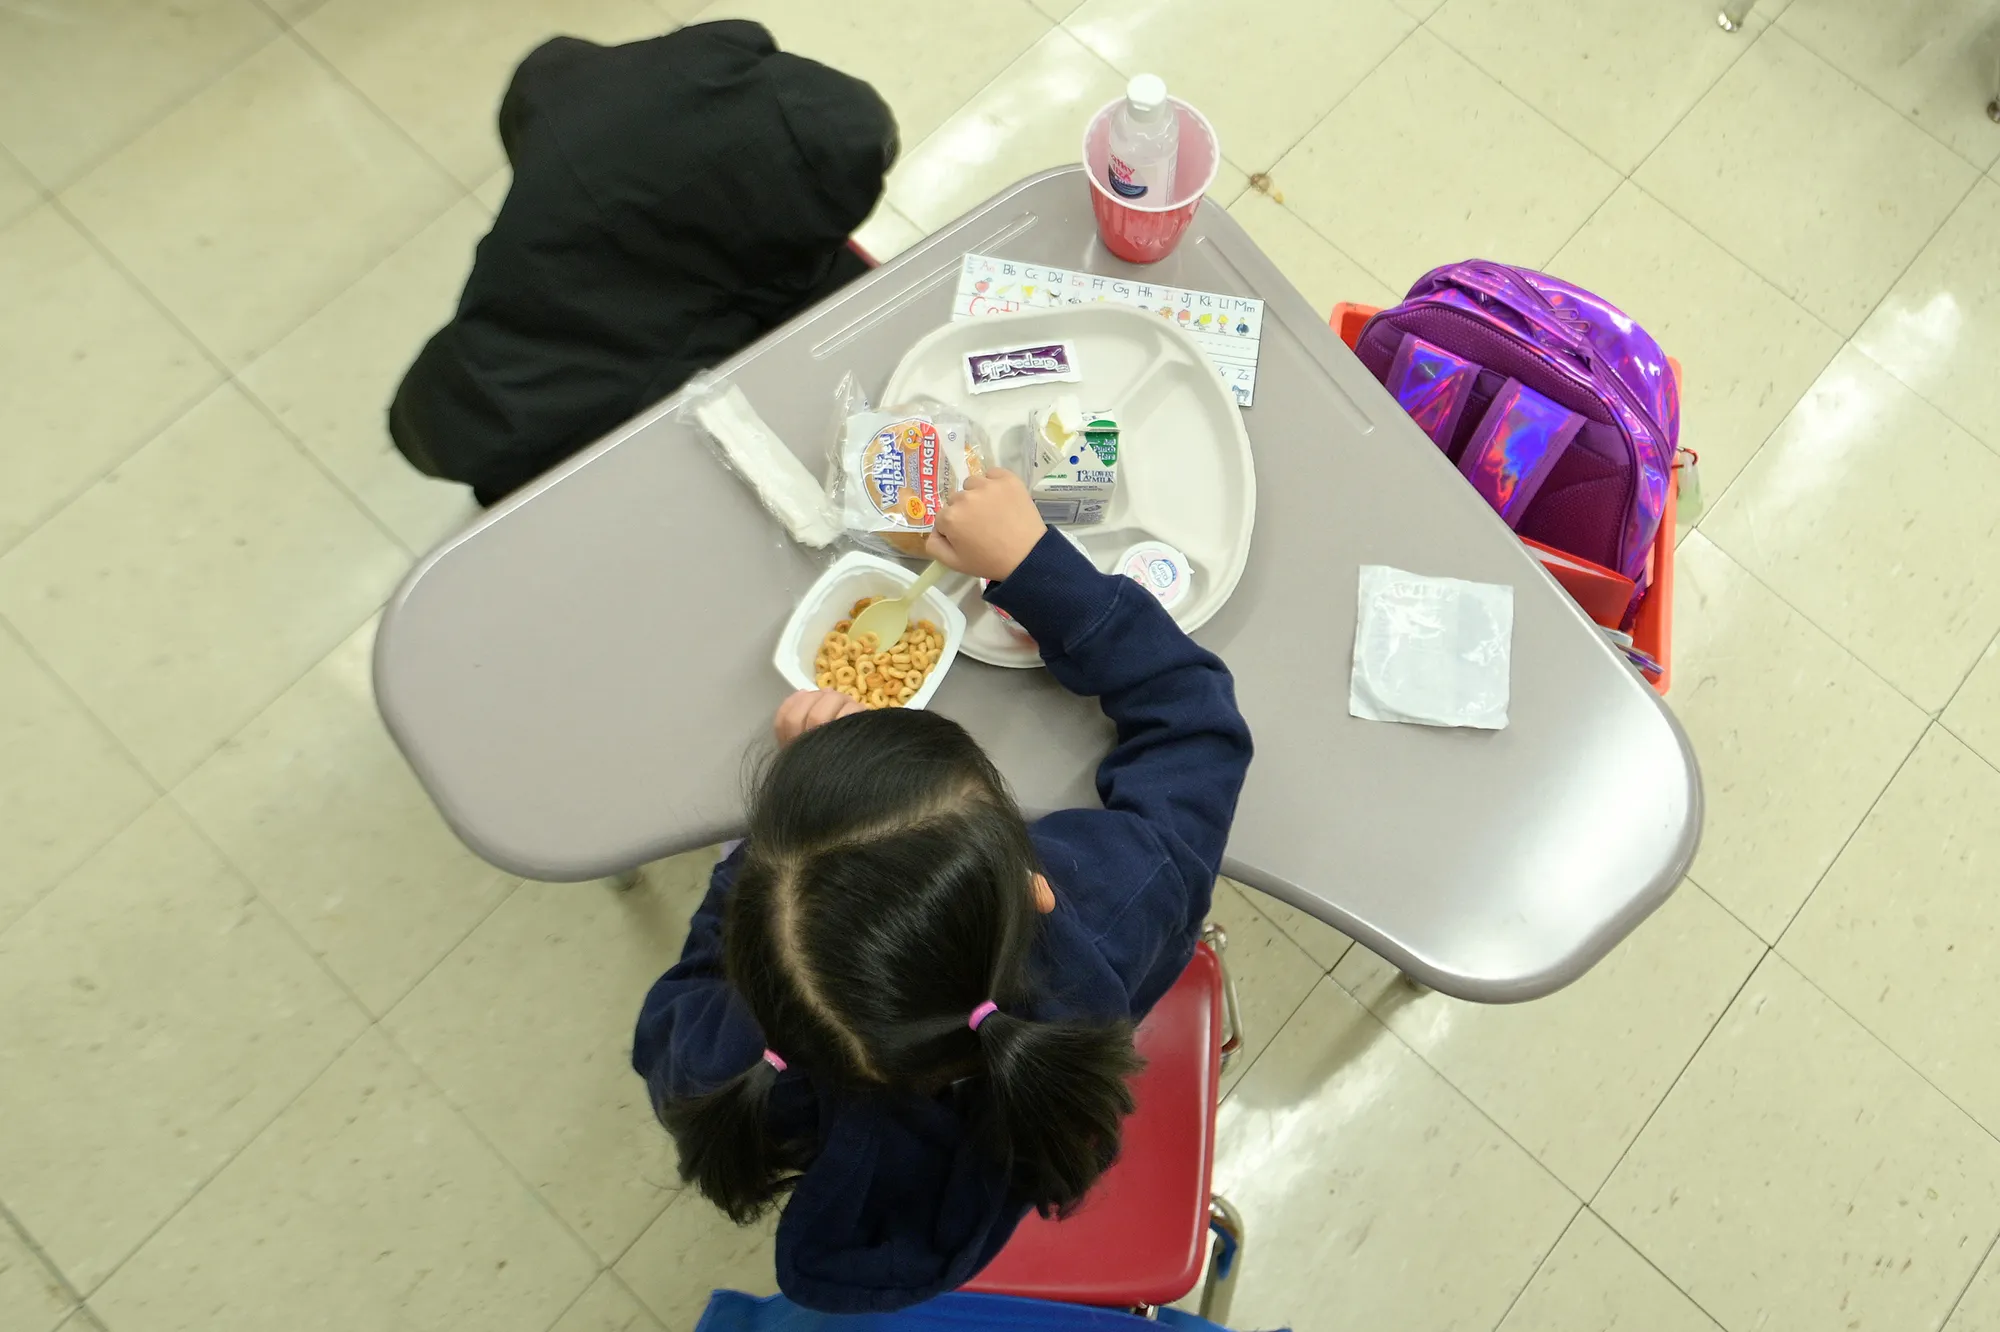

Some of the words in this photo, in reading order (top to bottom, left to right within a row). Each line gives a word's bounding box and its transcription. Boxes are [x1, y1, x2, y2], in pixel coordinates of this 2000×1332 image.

[1003, 264, 1016, 276] Bb
[1025, 268, 1038, 280] Cc
[1048, 272, 1063, 284] Dd
[1072, 276, 1084, 287] Ee
[1092, 279, 1105, 290] Ff
[1113, 282, 1129, 298] Gg
[1138, 286, 1152, 298] Hh
[1181, 293, 1192, 308] Jj
[1200, 296, 1212, 307] Kk
[1235, 300, 1255, 313] Mm
[1012, 352, 1059, 370] Grape
[1236, 368, 1250, 380] Zz
[923, 433, 935, 475] BAGEL
[924, 480, 936, 516] PLAIN
